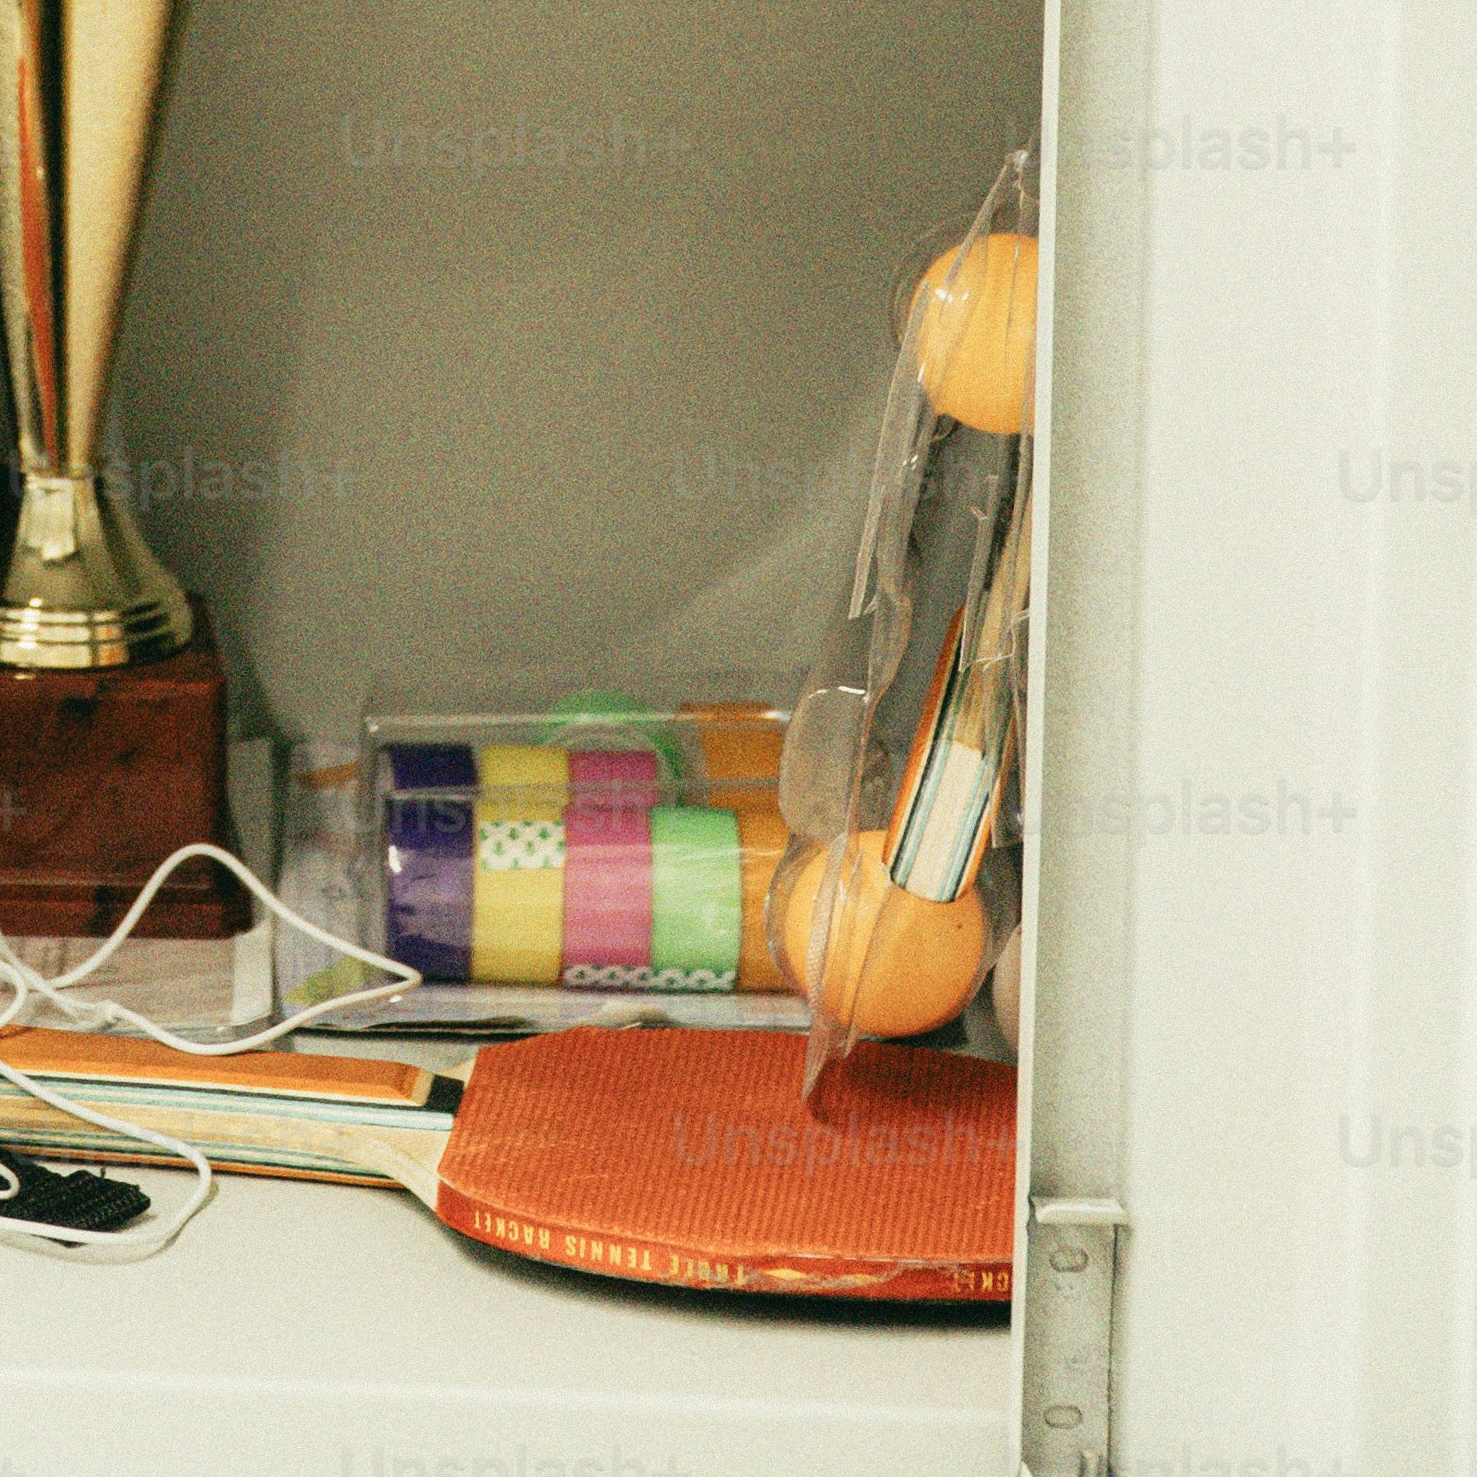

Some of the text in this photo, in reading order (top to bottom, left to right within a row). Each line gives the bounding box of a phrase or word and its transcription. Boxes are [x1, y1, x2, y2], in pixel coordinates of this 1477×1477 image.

[474, 1211, 551, 1251] RACKET
[565, 1235, 652, 1271] TENNIS
[952, 1271, 1012, 1293] CKET
